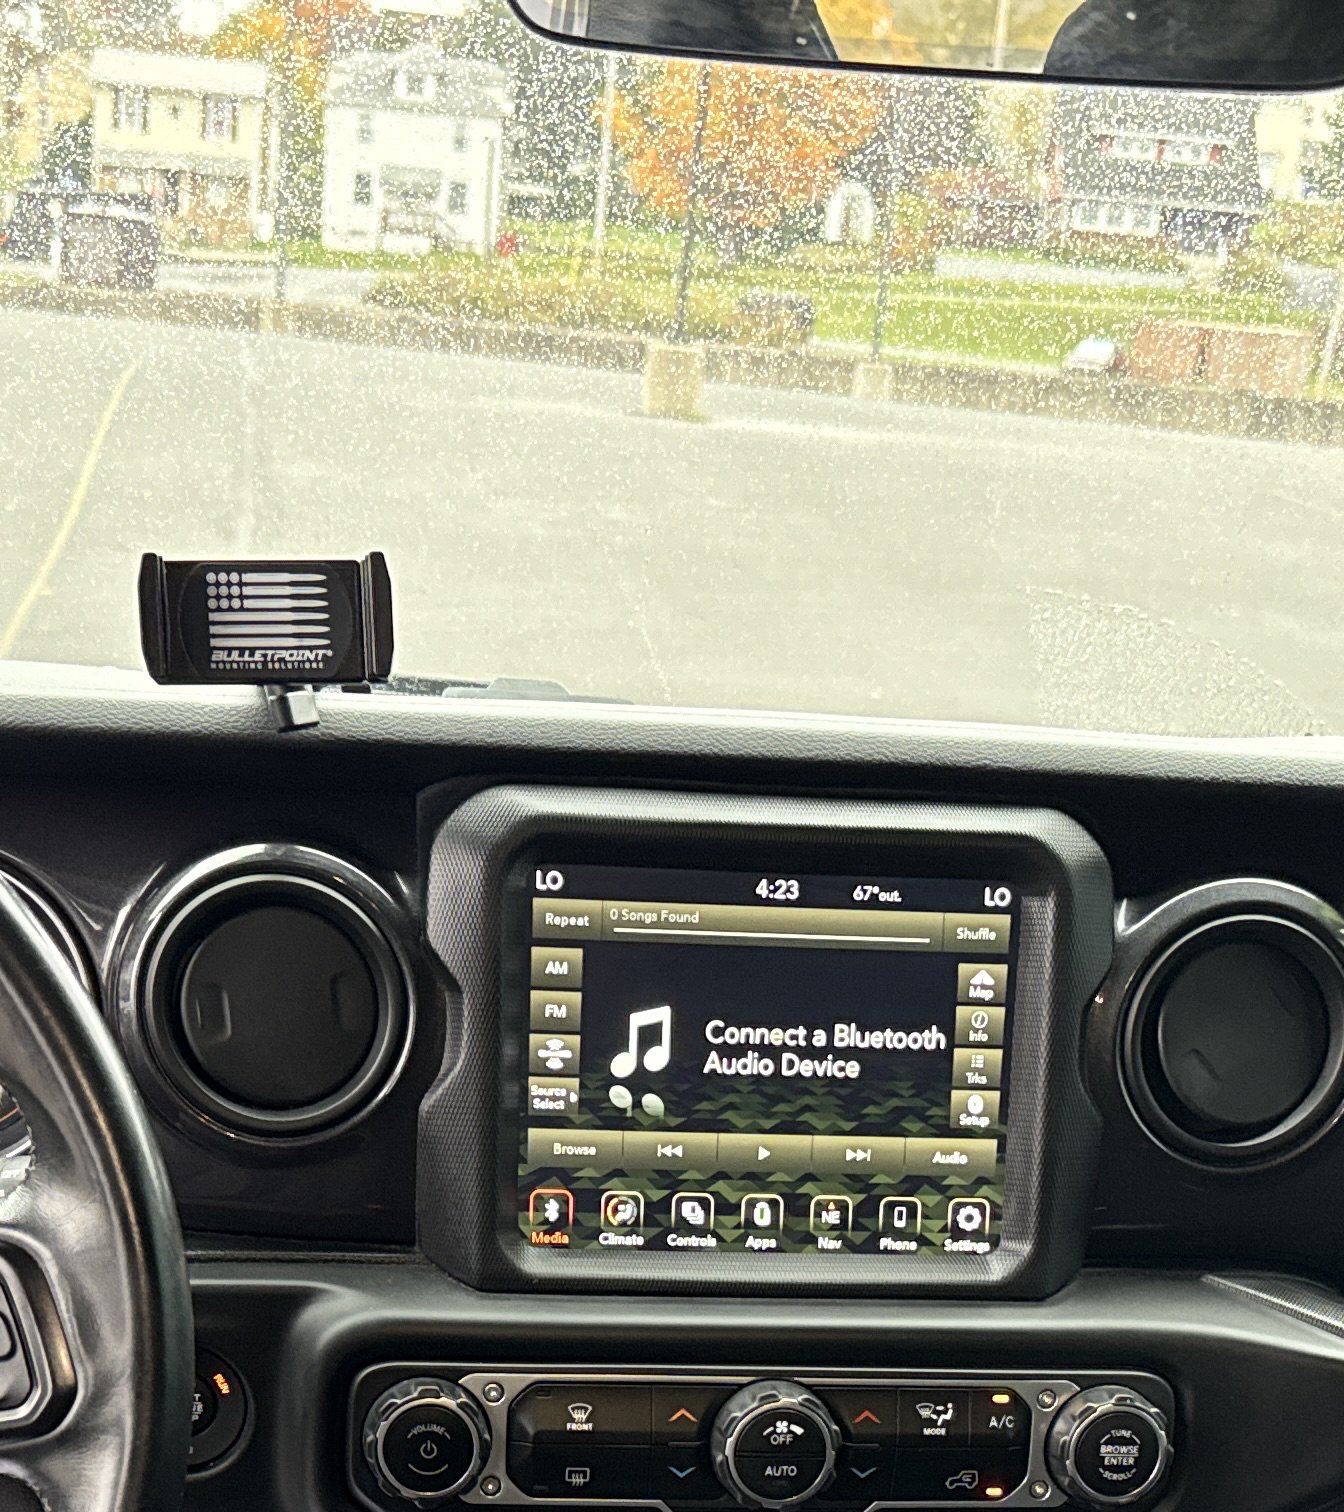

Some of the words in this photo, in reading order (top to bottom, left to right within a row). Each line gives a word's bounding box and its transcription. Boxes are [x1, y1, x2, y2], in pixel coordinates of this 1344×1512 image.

[210, 662, 263, 670] MOUNTING
[268, 662, 324, 670] SOLUTIONS
[535, 870, 563, 890] LO
[755, 879, 799, 901] 4:23
[984, 887, 1011, 907] LO
[545, 913, 588, 929] Repeat
[610, 909, 618, 922] 0
[621, 910, 657, 925] Songs
[660, 911, 699, 924] Found
[956, 927, 996, 942] Shuffle
[545, 961, 568, 976] AM
[968, 986, 994, 1001] Map
[545, 1005, 567, 1019] FM
[705, 1021, 806, 1047] Connect
[812, 1031, 825, 1047] a
[833, 1023, 946, 1050] Bluetooth
[968, 1029, 988, 1043] Info
[703, 1052, 773, 1078] Audio
[781, 1053, 860, 1079] Device
[966, 1071, 987, 1085] Trks
[530, 1085, 567, 1099] Source
[533, 1098, 565, 1111] Select
[959, 1113, 989, 1128] Setup
[553, 1143, 596, 1157] Browse
[933, 1152, 967, 1166] Audio
[821, 1210, 840, 1224] NE
[531, 1231, 569, 1246] Media
[599, 1232, 644, 1247] Climate
[667, 1234, 717, 1248] Controls
[745, 1236, 776, 1252] Apps
[818, 1237, 841, 1251] Nav
[879, 1238, 917, 1252] Phone
[944, 1237, 990, 1254] Settings
[213, 1374, 230, 1394] RUN
[566, 1422, 593, 1431] FRONT
[989, 1415, 1014, 1428] A/C
[411, 1424, 446, 1436] VOLUME
[923, 1427, 946, 1436] MODE
[1110, 1429, 1132, 1439] TUNE
[770, 1434, 794, 1445] OFF
[1100, 1444, 1139, 1455] BROWSE
[1104, 1456, 1135, 1466] ENTER
[764, 1466, 797, 1477] AUTO
[1103, 1469, 1133, 1481] SCROLL
